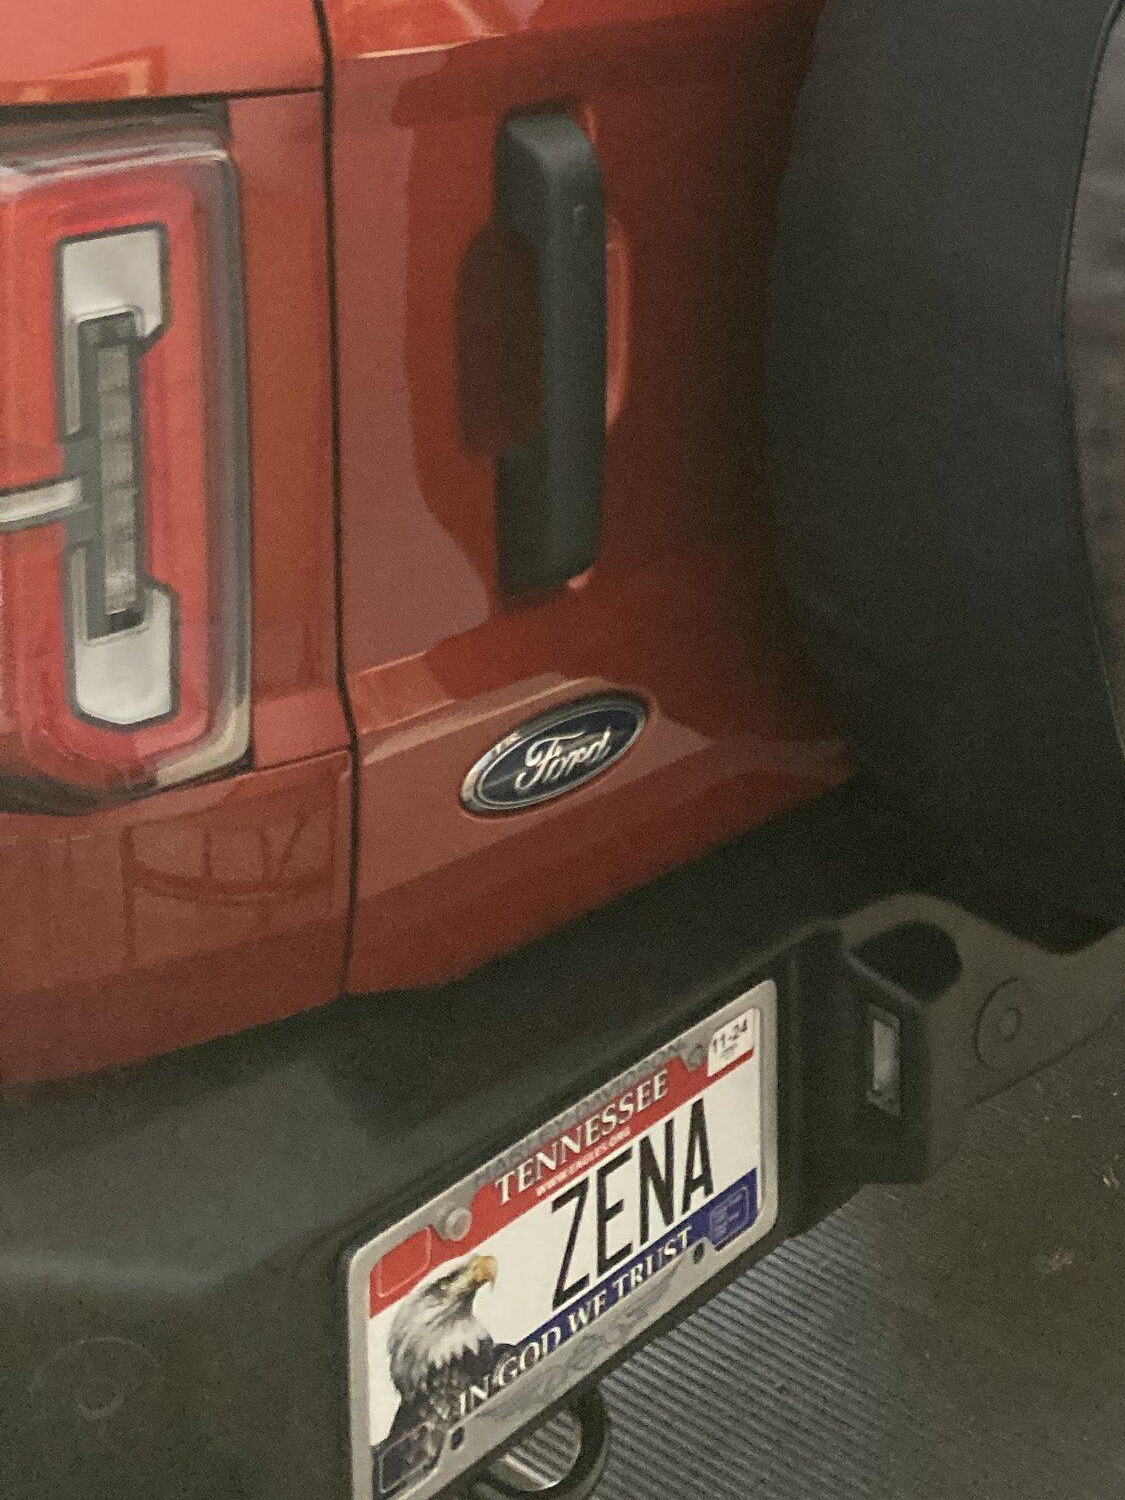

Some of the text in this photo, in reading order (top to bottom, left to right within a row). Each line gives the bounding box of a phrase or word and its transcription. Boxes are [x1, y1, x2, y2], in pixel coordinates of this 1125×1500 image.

[514, 725, 613, 791] Ford
[494, 1068, 668, 1205] TENNESSEE
[551, 1097, 714, 1312] ZENA
[458, 1225, 693, 1418] IN GOD WE TRUST
